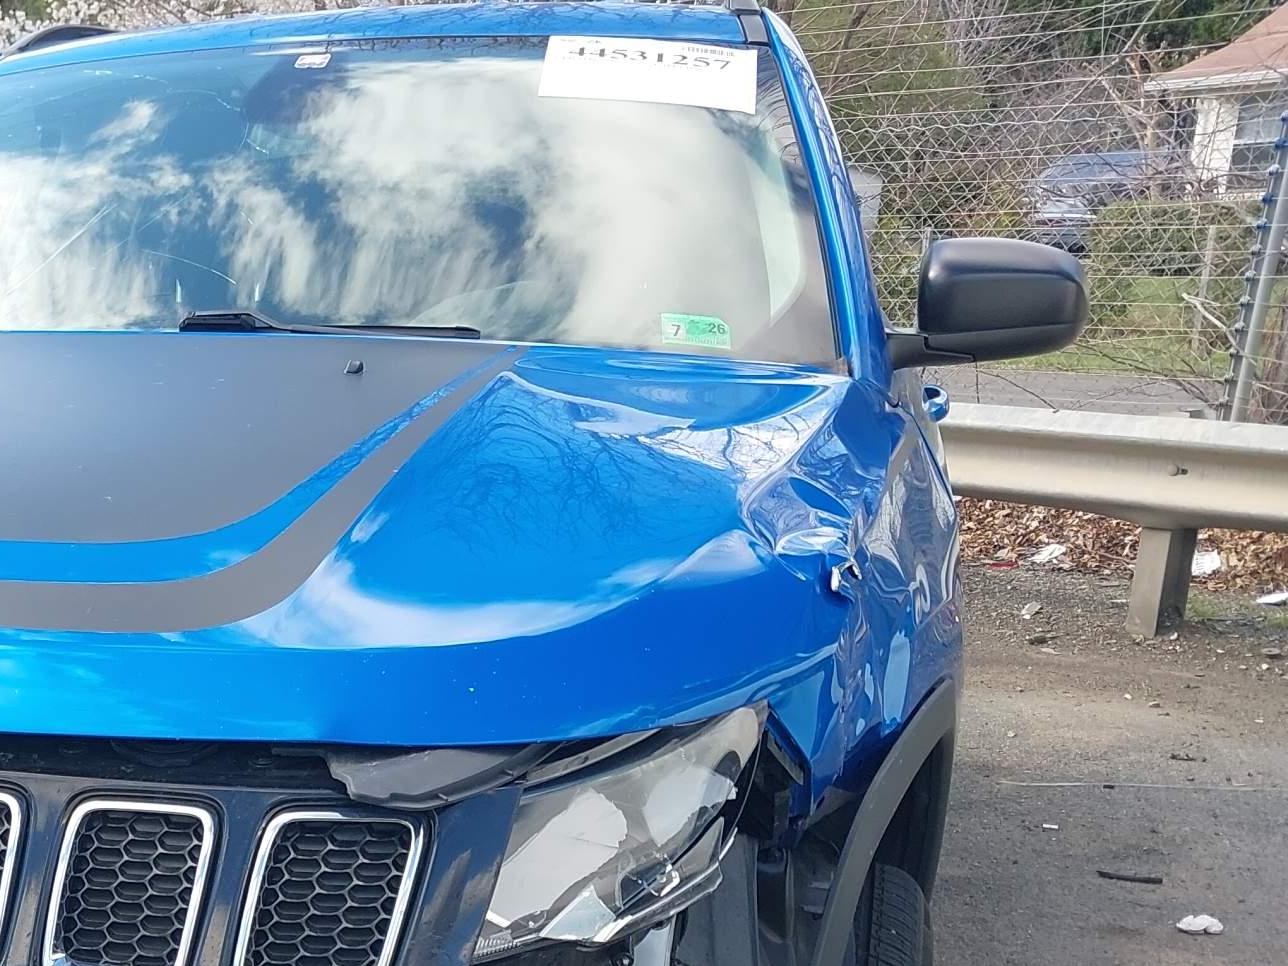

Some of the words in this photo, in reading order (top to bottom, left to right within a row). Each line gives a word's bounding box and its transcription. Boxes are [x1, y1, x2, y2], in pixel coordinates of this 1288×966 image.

[569, 46, 731, 70] 44531257
[671, 323, 681, 337] 7
[708, 322, 726, 335] 26
